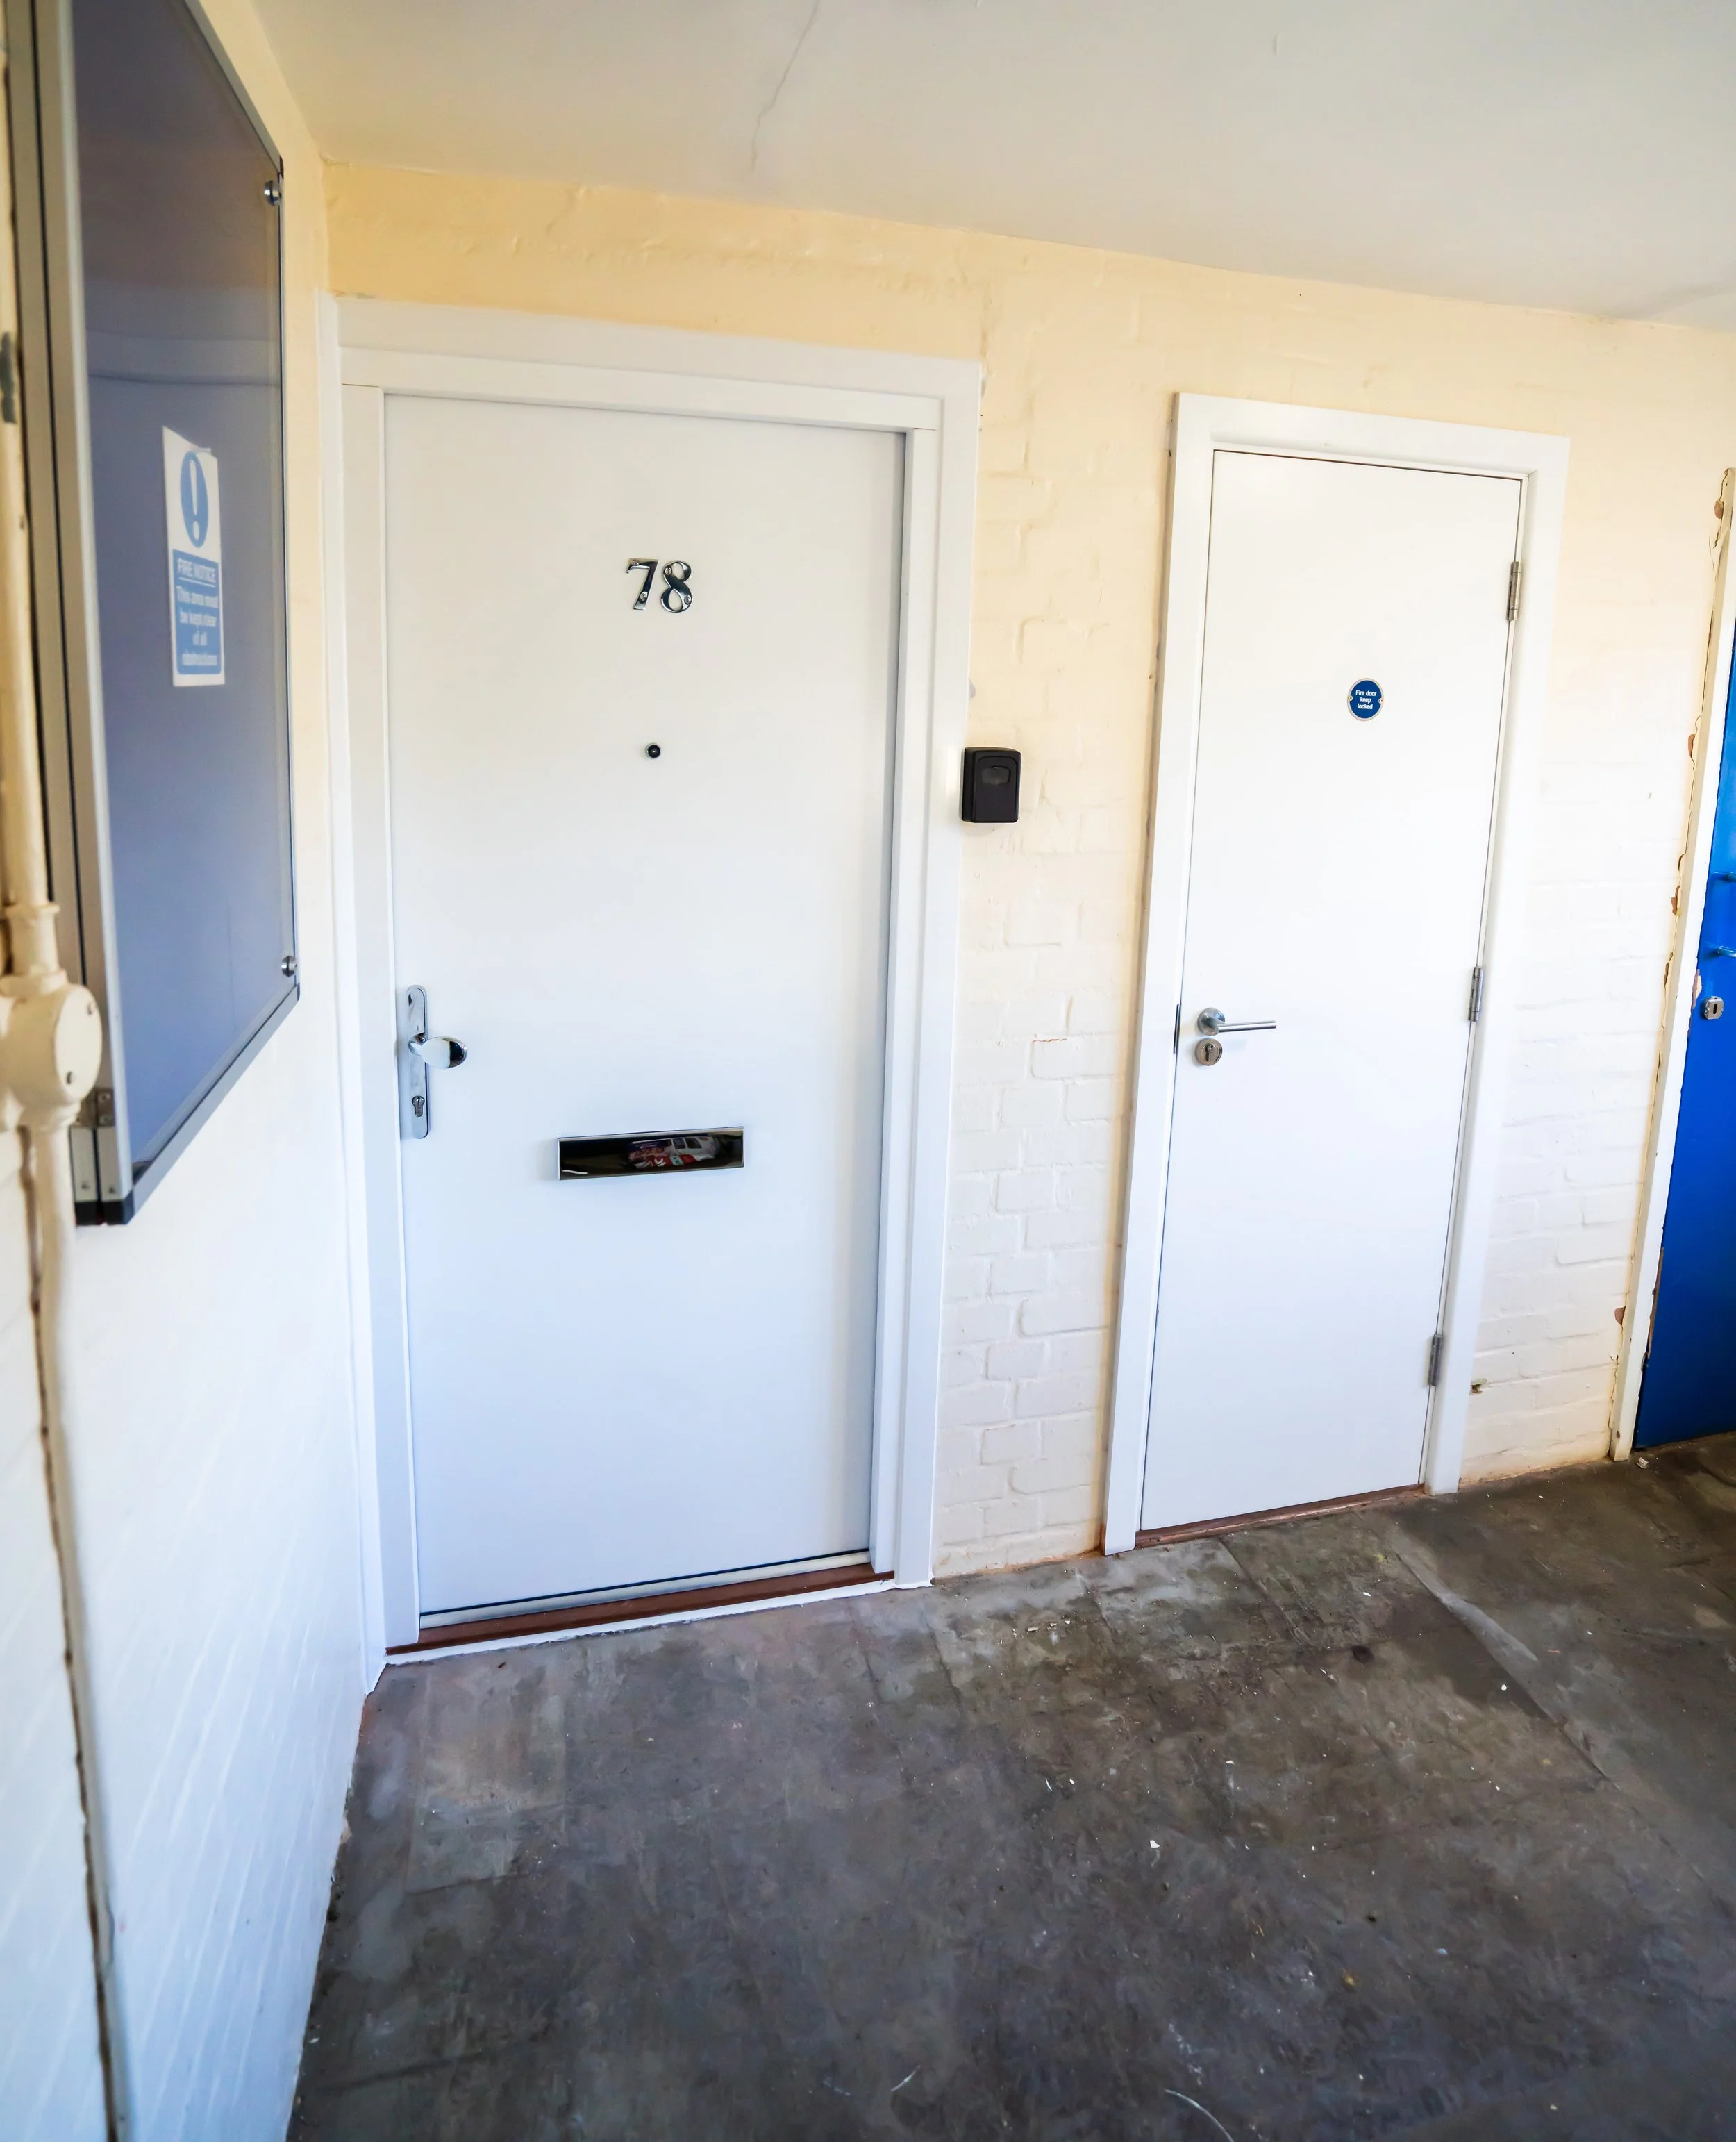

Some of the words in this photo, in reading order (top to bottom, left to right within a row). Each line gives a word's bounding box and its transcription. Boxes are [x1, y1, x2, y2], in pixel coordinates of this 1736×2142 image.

[178, 558, 193, 577] FIRE
[194, 563, 216, 583] NOTICE
[626, 558, 692, 613] 78
